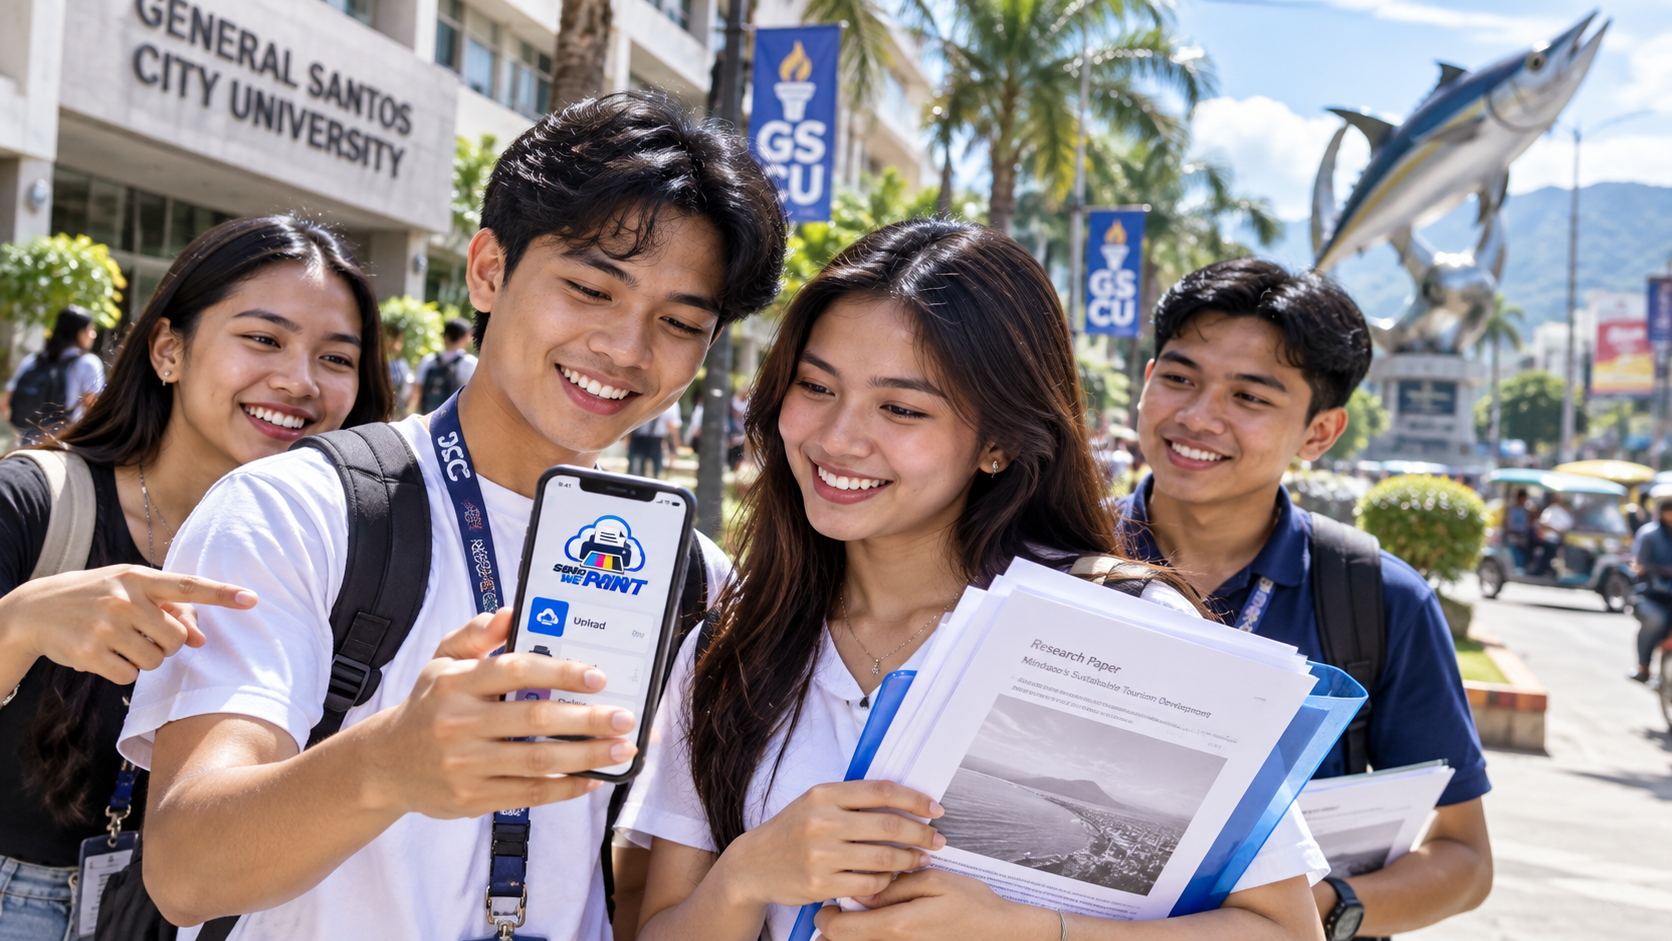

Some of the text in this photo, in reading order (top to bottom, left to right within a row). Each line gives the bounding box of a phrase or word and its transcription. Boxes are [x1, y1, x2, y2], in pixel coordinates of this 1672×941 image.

[134, 0, 413, 136] GENERAL SANTOS
[132, 43, 406, 178] CITY UNIVERSITY
[756, 119, 827, 164] GS
[1088, 268, 1137, 299] GS
[1088, 298, 1136, 328] CU
[560, 573, 584, 585] WE
[1030, 638, 1122, 675] Research Paper
